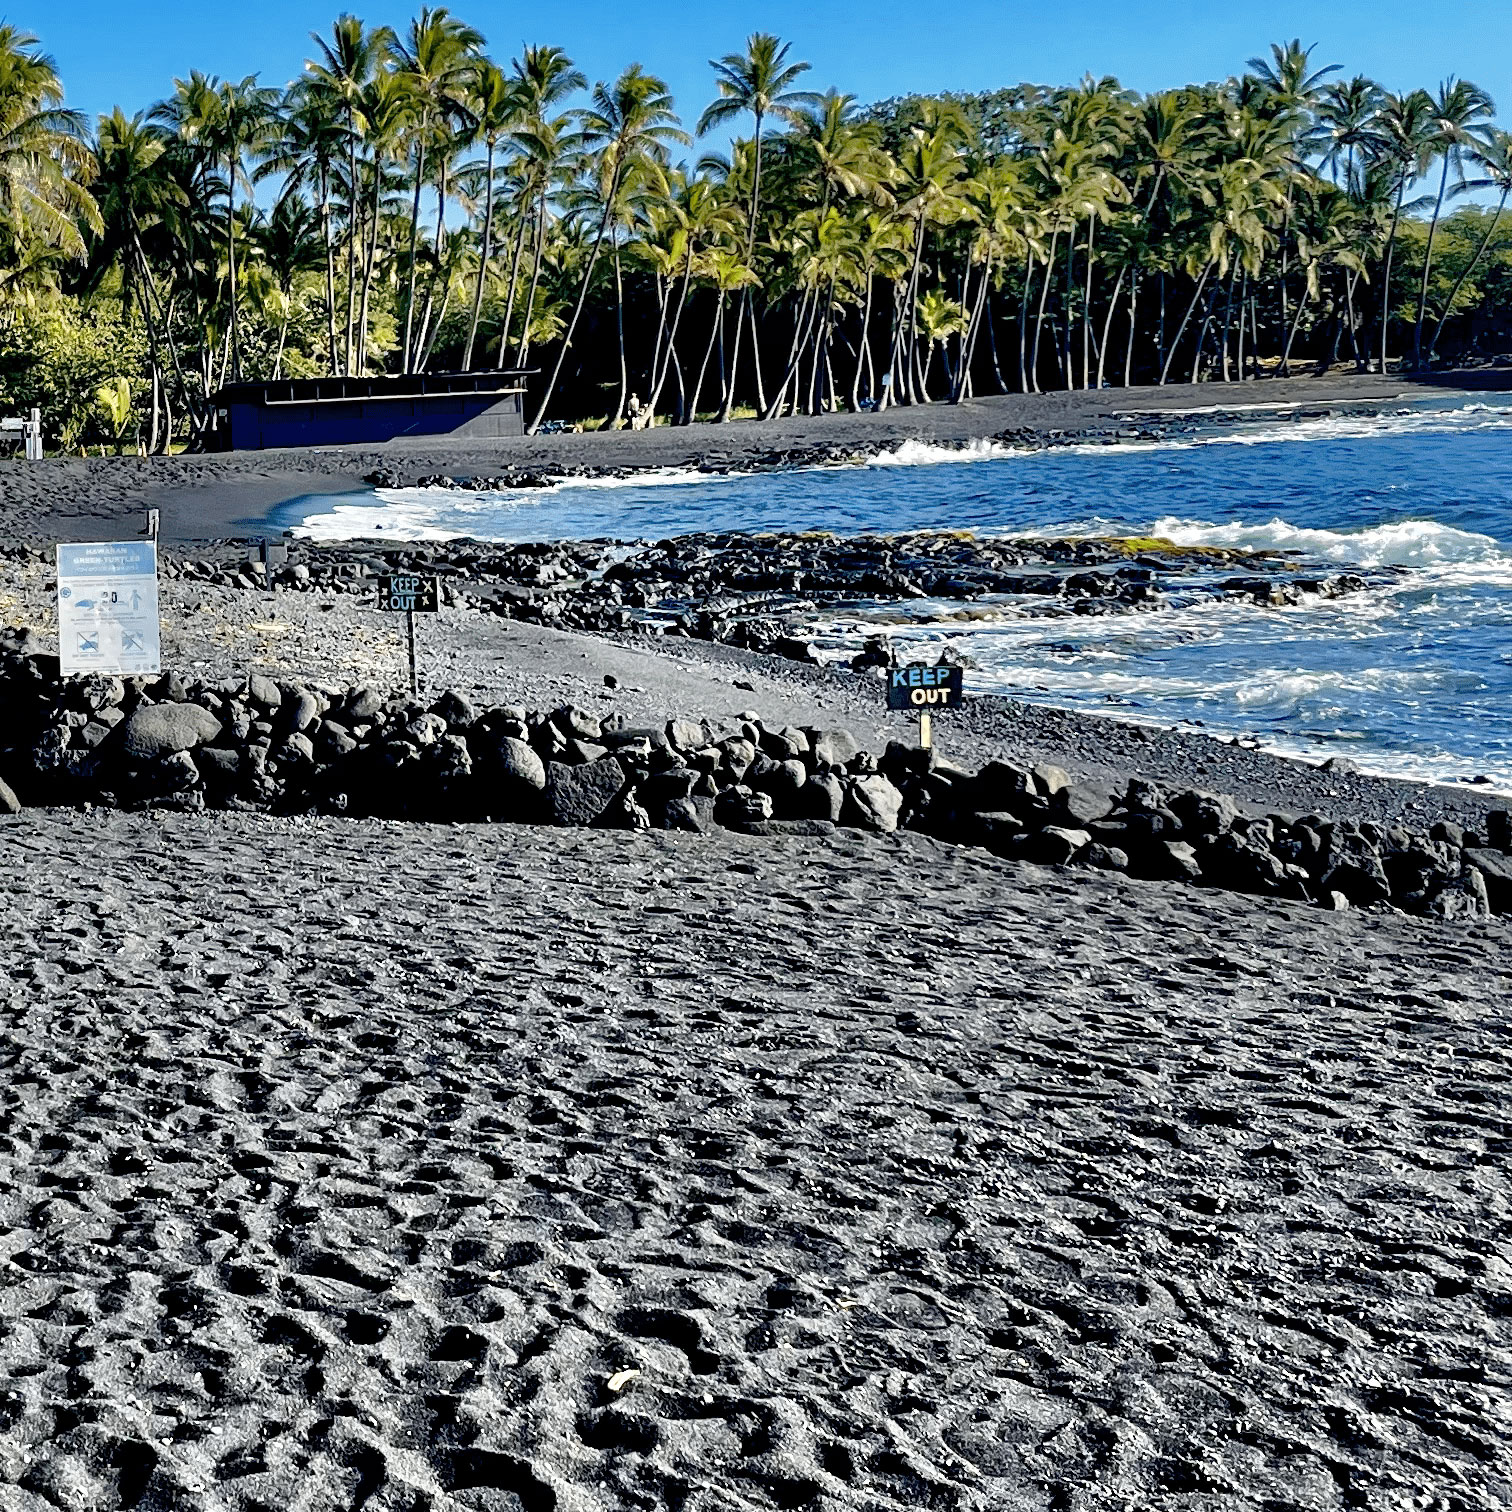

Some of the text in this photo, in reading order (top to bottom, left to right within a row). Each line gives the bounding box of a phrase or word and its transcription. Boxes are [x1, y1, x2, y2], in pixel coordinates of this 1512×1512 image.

[390, 576, 419, 593] KEEP
[390, 595, 416, 610] OUT
[892, 668, 950, 687] KEEP
[911, 688, 951, 705] OUT
